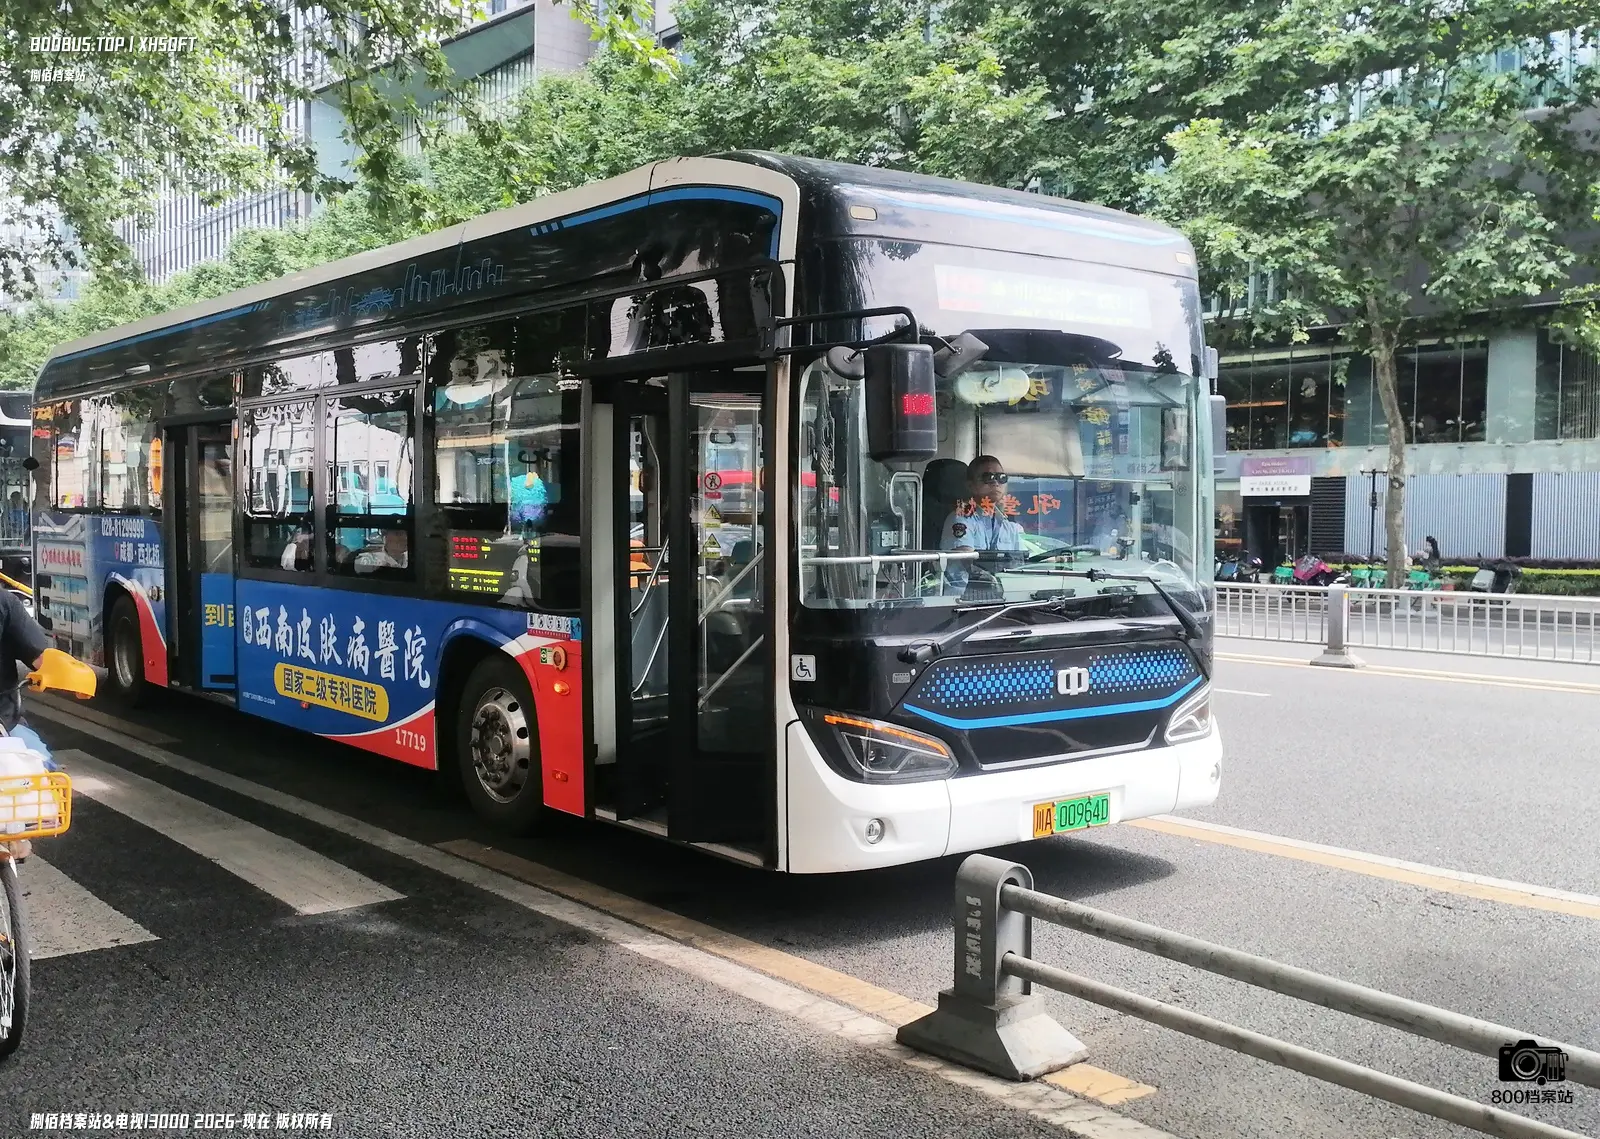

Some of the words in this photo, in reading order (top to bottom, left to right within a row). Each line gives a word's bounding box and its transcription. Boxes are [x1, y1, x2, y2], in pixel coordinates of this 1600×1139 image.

[283, 667, 377, 715] 国家二级专科医院
[395, 728, 426, 752] 17719
